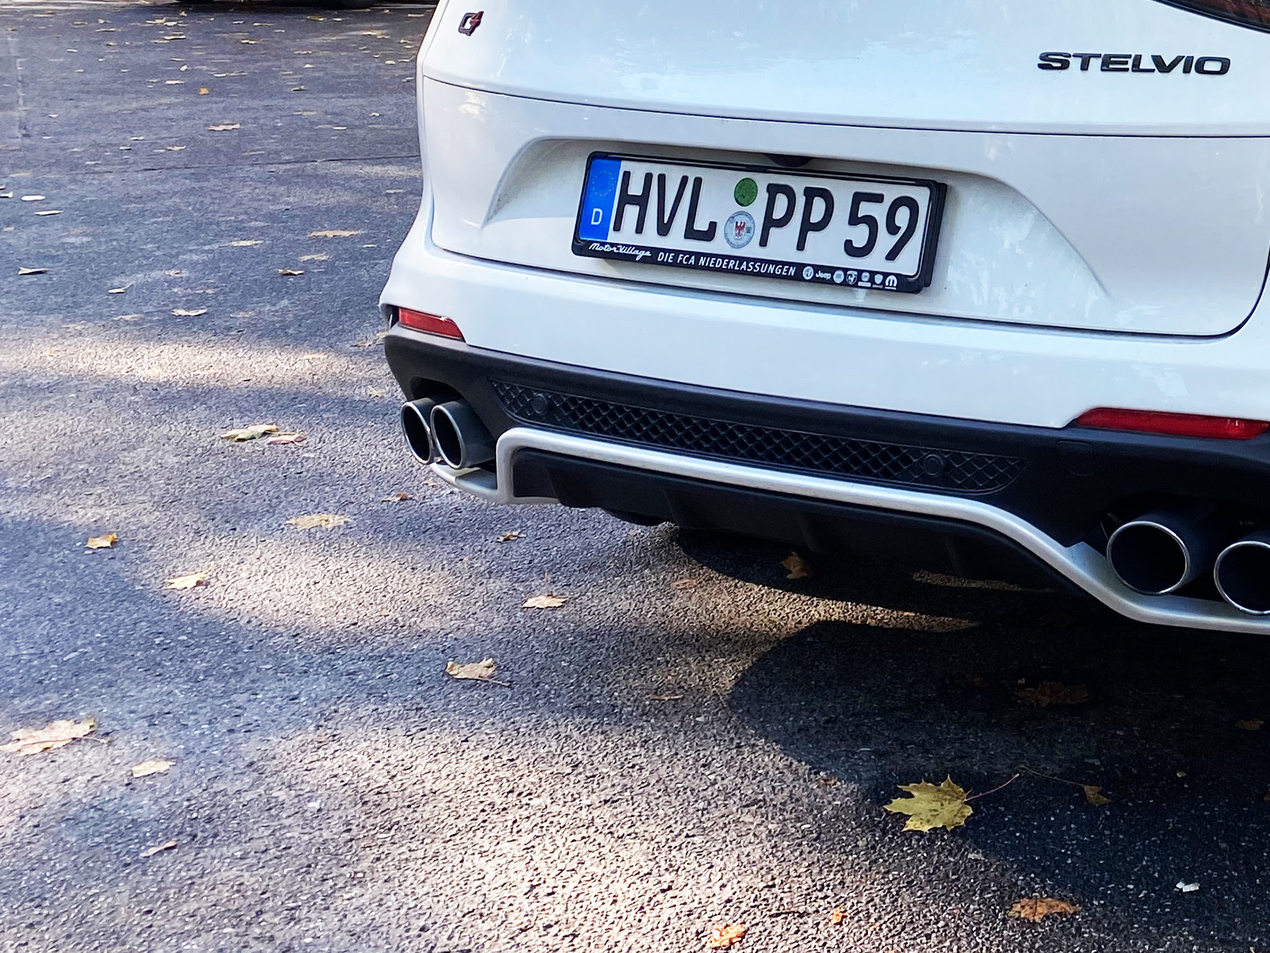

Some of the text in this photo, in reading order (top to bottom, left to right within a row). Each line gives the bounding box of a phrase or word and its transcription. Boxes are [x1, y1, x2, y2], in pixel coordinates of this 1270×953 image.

[1037, 51, 1232, 76] STELVIO
[590, 208, 603, 226] D
[612, 170, 718, 242] HVL
[759, 182, 835, 252] PP
[843, 191, 921, 262] 59
[657, 251, 675, 263] DIE
[677, 254, 696, 266] FCA
[698, 256, 797, 277] NIEDERLASSUNGEN
[815, 270, 832, 280] Jeep
